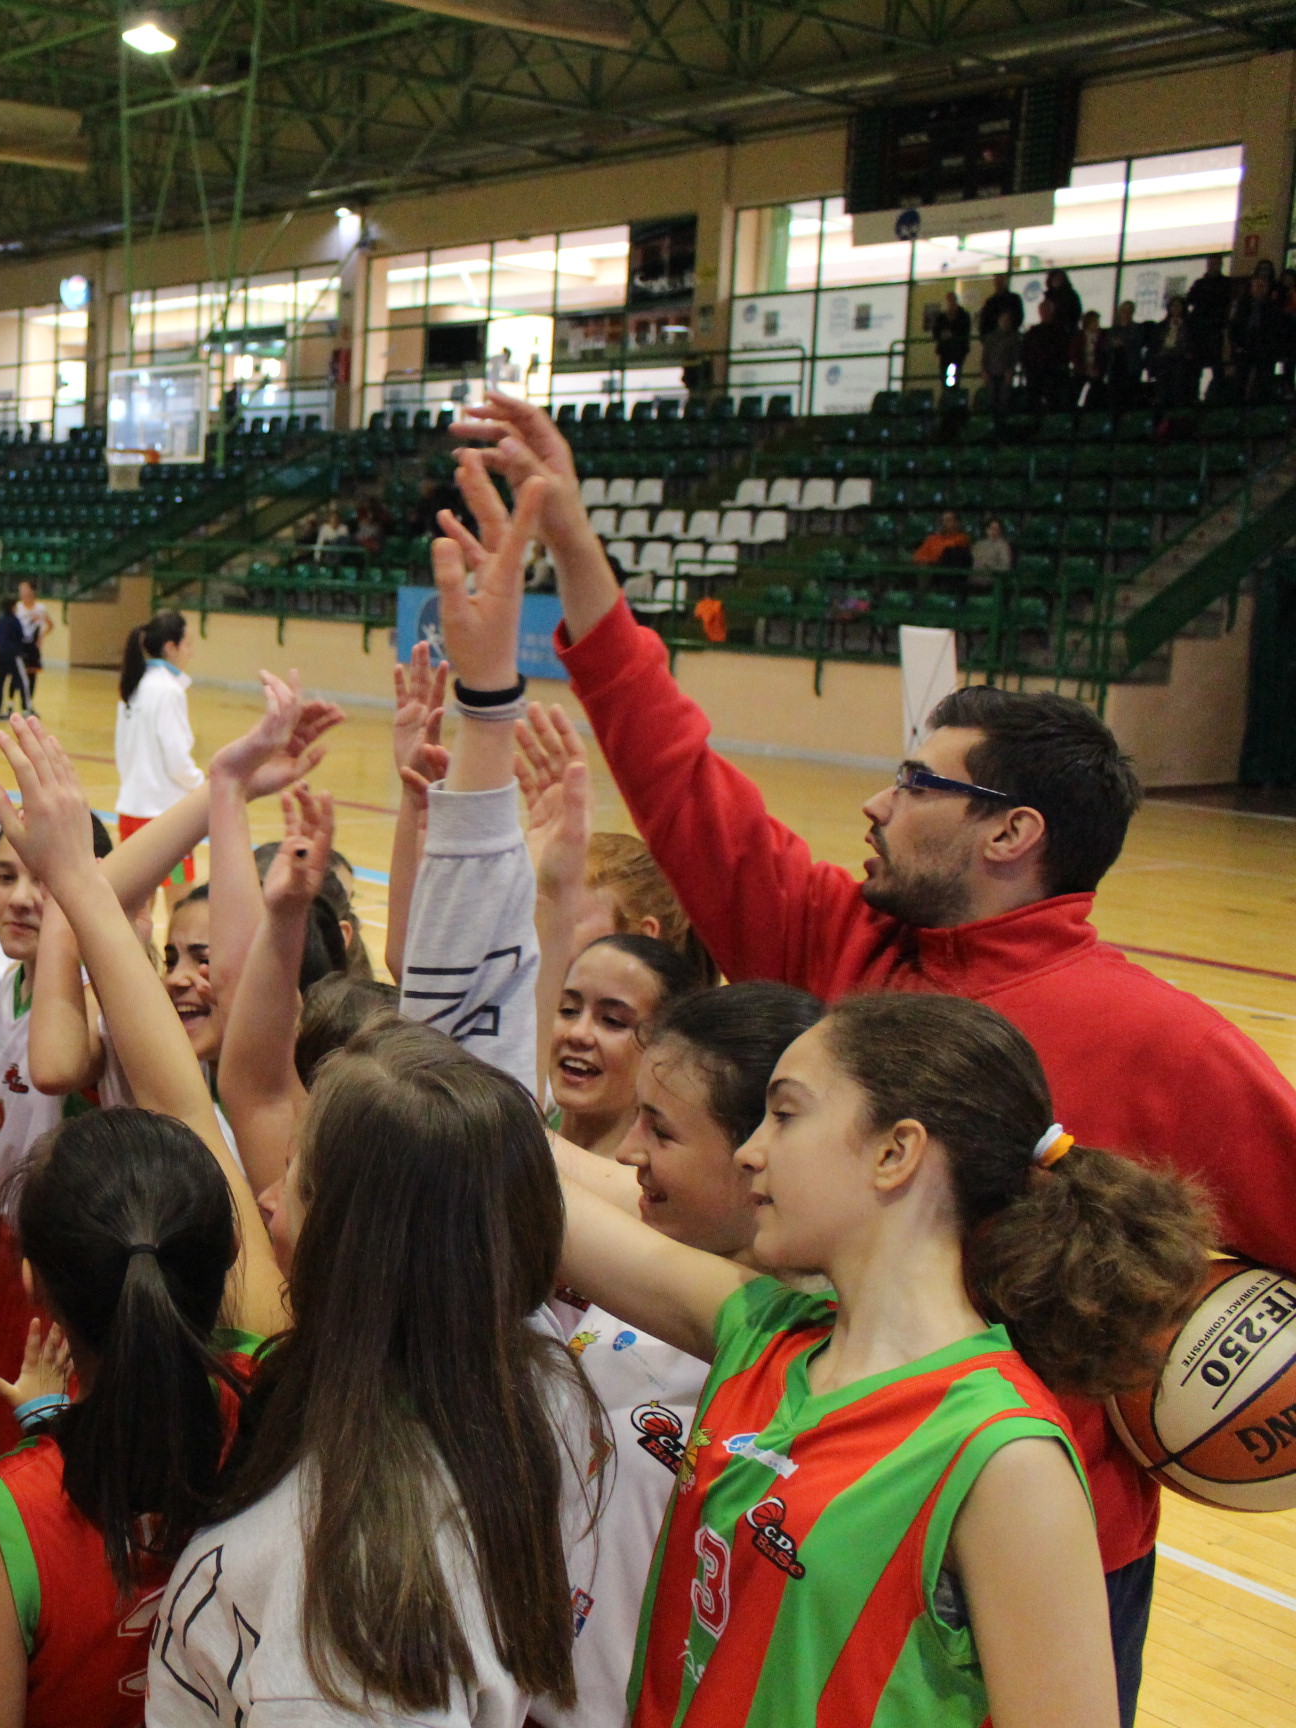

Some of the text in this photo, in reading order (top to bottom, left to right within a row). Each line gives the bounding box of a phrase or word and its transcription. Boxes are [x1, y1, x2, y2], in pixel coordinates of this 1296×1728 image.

[1223, 1285, 1260, 1317] SURFACE
[1180, 1315, 1227, 1368] COMPOSITE
[764, 1525, 794, 1555] C.D.
